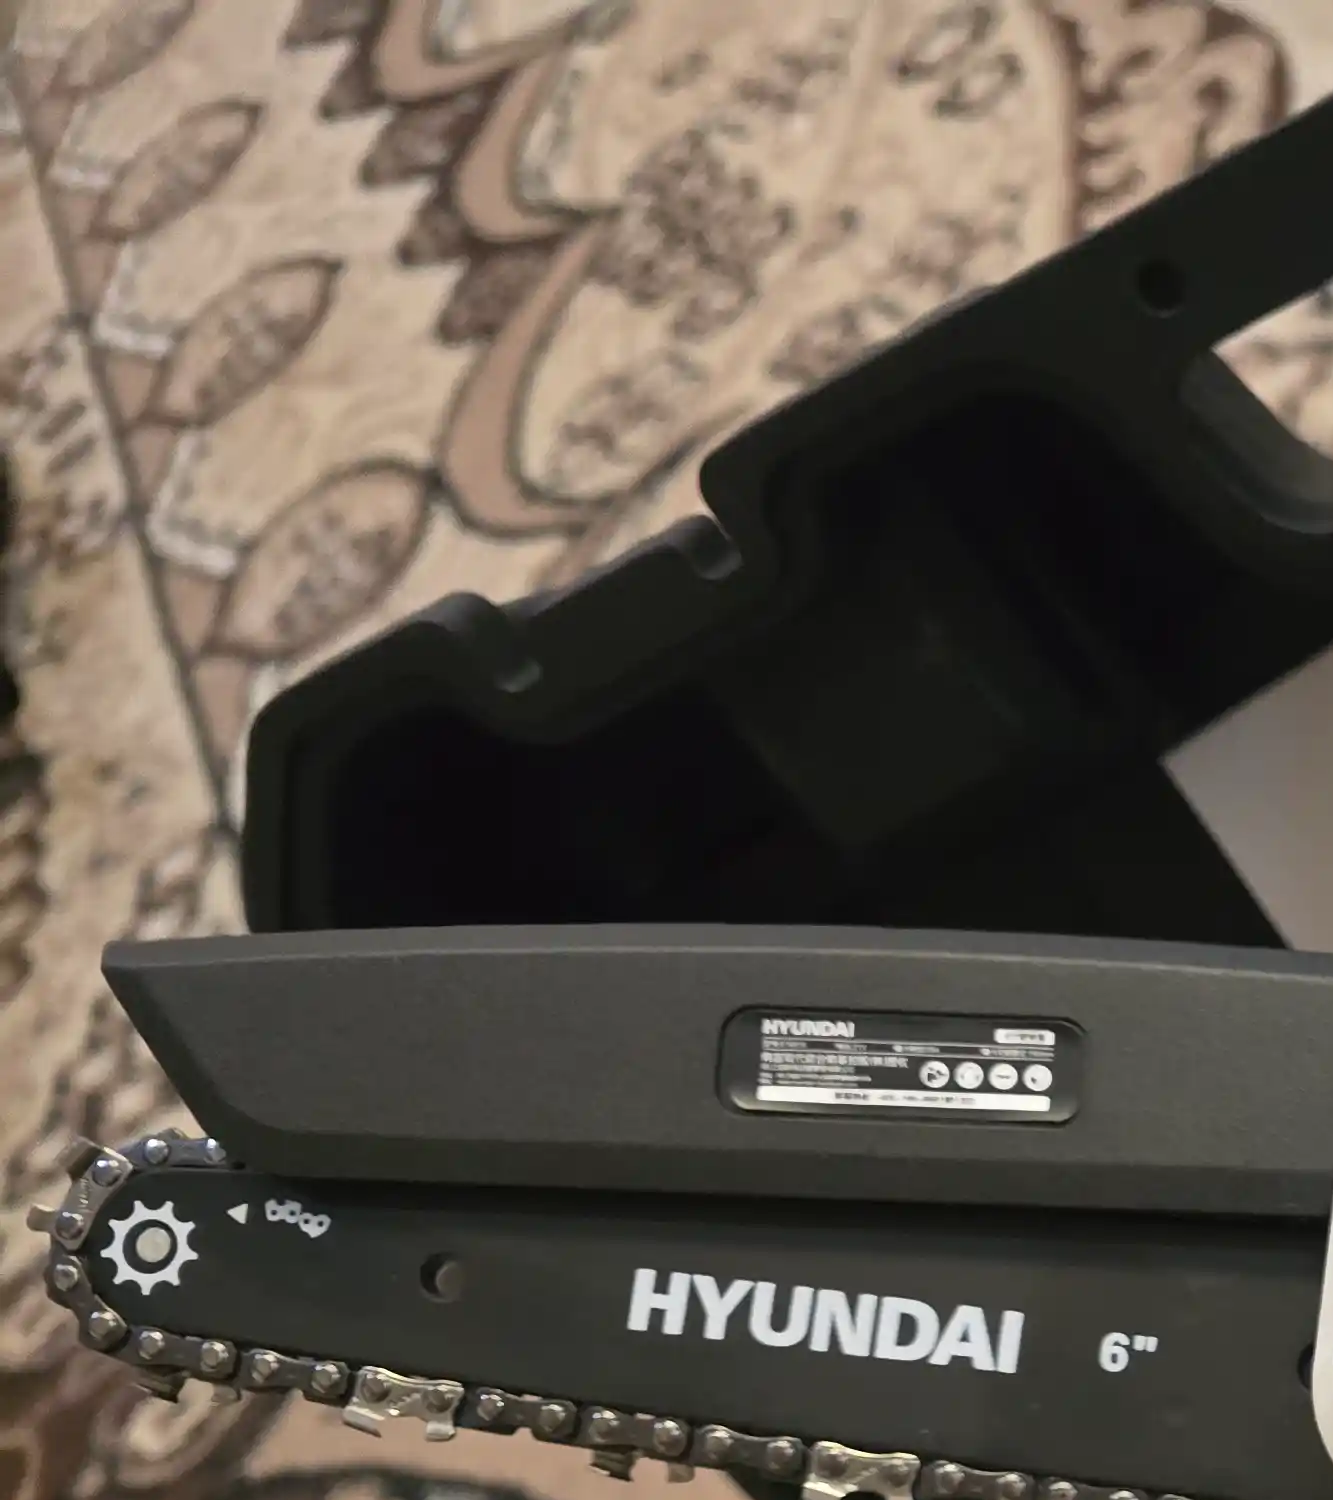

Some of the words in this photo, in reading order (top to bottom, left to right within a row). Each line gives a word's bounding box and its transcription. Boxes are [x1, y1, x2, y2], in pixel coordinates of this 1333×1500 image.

[761, 1018, 855, 1037] HYUNDAI
[626, 1268, 1025, 1374] HYUNDAI
[1099, 1332, 1159, 1372] 6"
